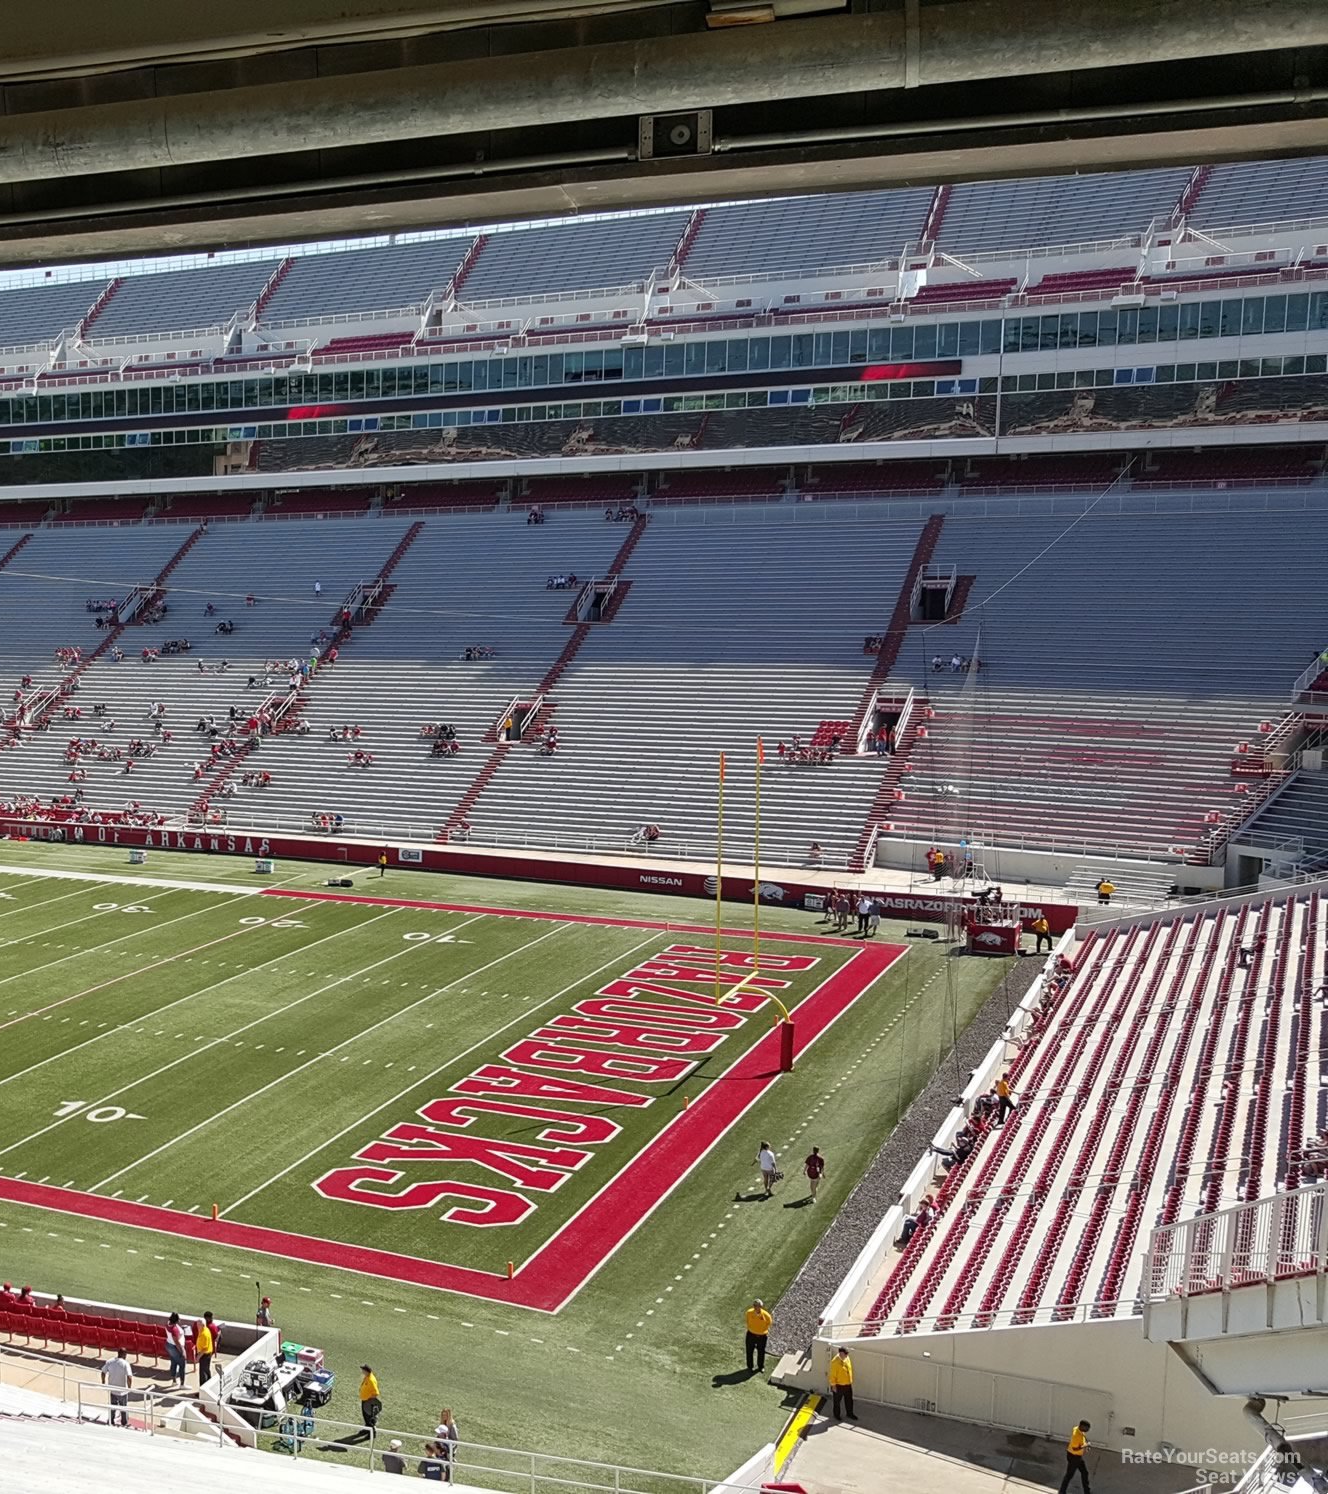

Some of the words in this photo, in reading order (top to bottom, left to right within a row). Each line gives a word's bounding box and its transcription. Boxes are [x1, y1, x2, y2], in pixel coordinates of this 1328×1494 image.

[145, 830, 270, 854] ARKANSAS
[639, 874, 683, 887] NISSAN
[311, 944, 823, 1229] RAZORBACKS
[52, 1100, 127, 1123] 10
